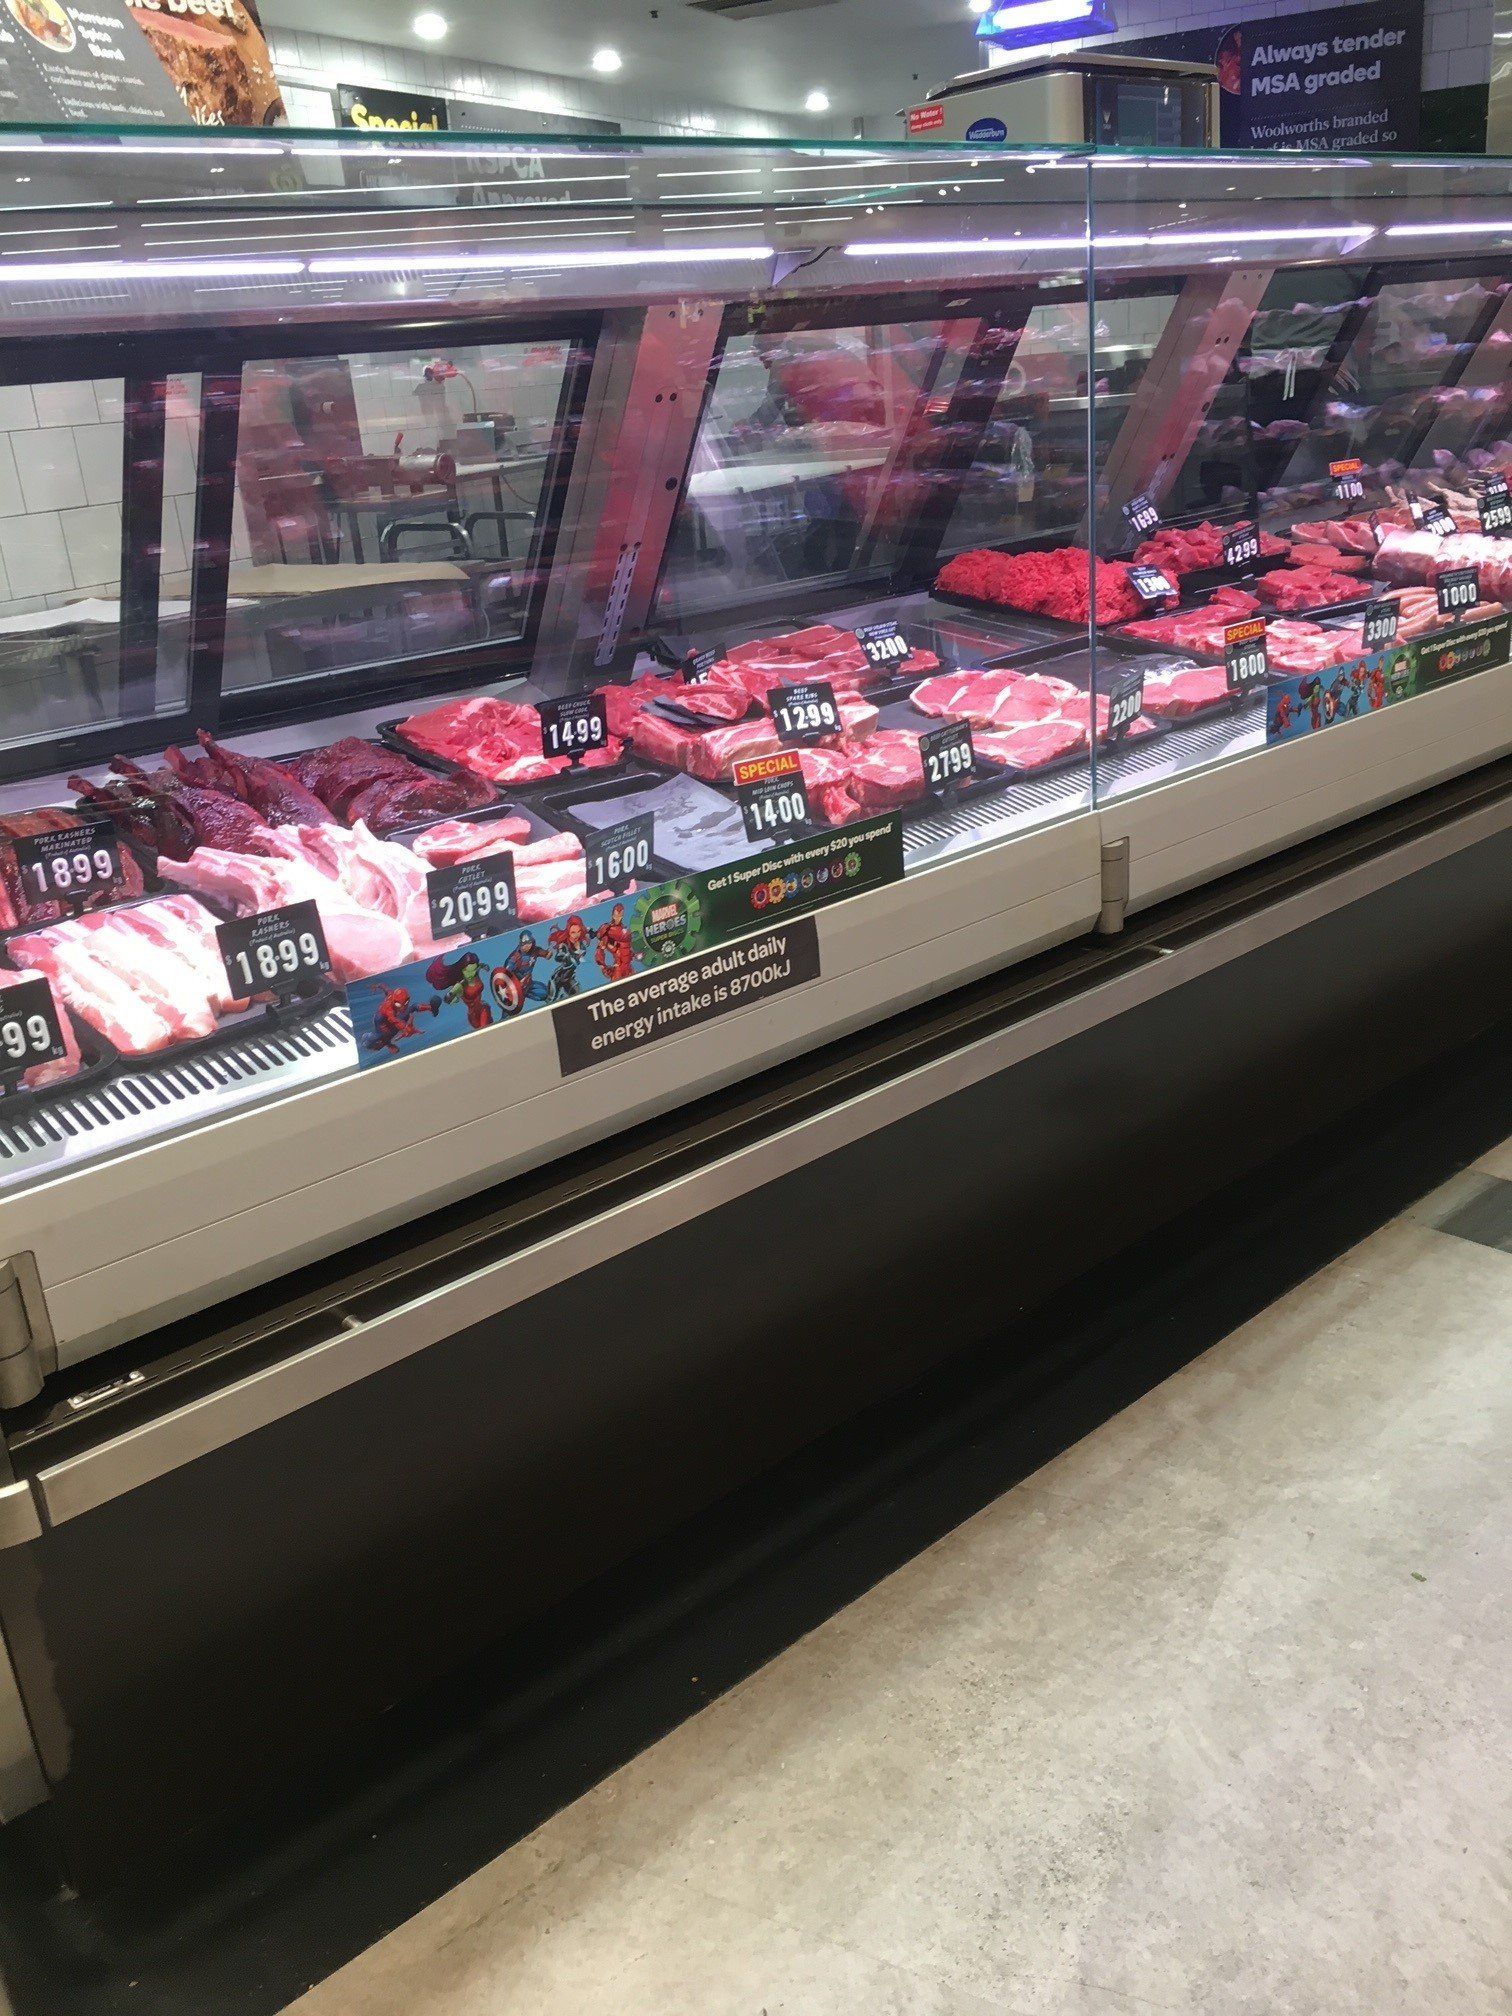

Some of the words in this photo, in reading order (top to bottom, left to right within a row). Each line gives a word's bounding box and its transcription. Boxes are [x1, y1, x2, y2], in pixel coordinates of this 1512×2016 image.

[1250, 41, 1329, 66] Always
[1332, 28, 1406, 53] tender
[1251, 72, 1300, 97] MSA
[1304, 60, 1382, 94] graded
[1250, 117, 1330, 139] Woolworths
[1333, 109, 1389, 129] branded
[1332, 130, 1379, 150] graded
[1382, 130, 1397, 141] so
[1332, 462, 1360, 473] SPECIAL
[1227, 622, 1263, 641] SPECIAL
[739, 755, 798, 780] SPECIAL
[34, 835, 56, 846] PORK
[57, 827, 96, 841] RASHERS
[40, 836, 93, 853] MARINATED
[707, 876, 727, 891] Get
[732, 866, 761, 883] Super
[761, 860, 783, 874] Disc
[783, 851, 805, 867] with
[805, 845, 830, 860] every
[830, 836, 848, 852] $20
[847, 833, 865, 849] you
[458, 870, 486, 884] CUTLET
[251, 920, 290, 937] RASHERS
[257, 913, 280, 926] PORK
[645, 914, 687, 938] HEROES
[587, 995, 625, 1022] The
[627, 969, 699, 1007] average
[700, 950, 747, 980] adult
[748, 935, 787, 963] daily
[590, 1013, 655, 1051] energy
[656, 994, 712, 1026] intake
[713, 985, 729, 1003] is
[729, 958, 792, 996] 8700kJ
